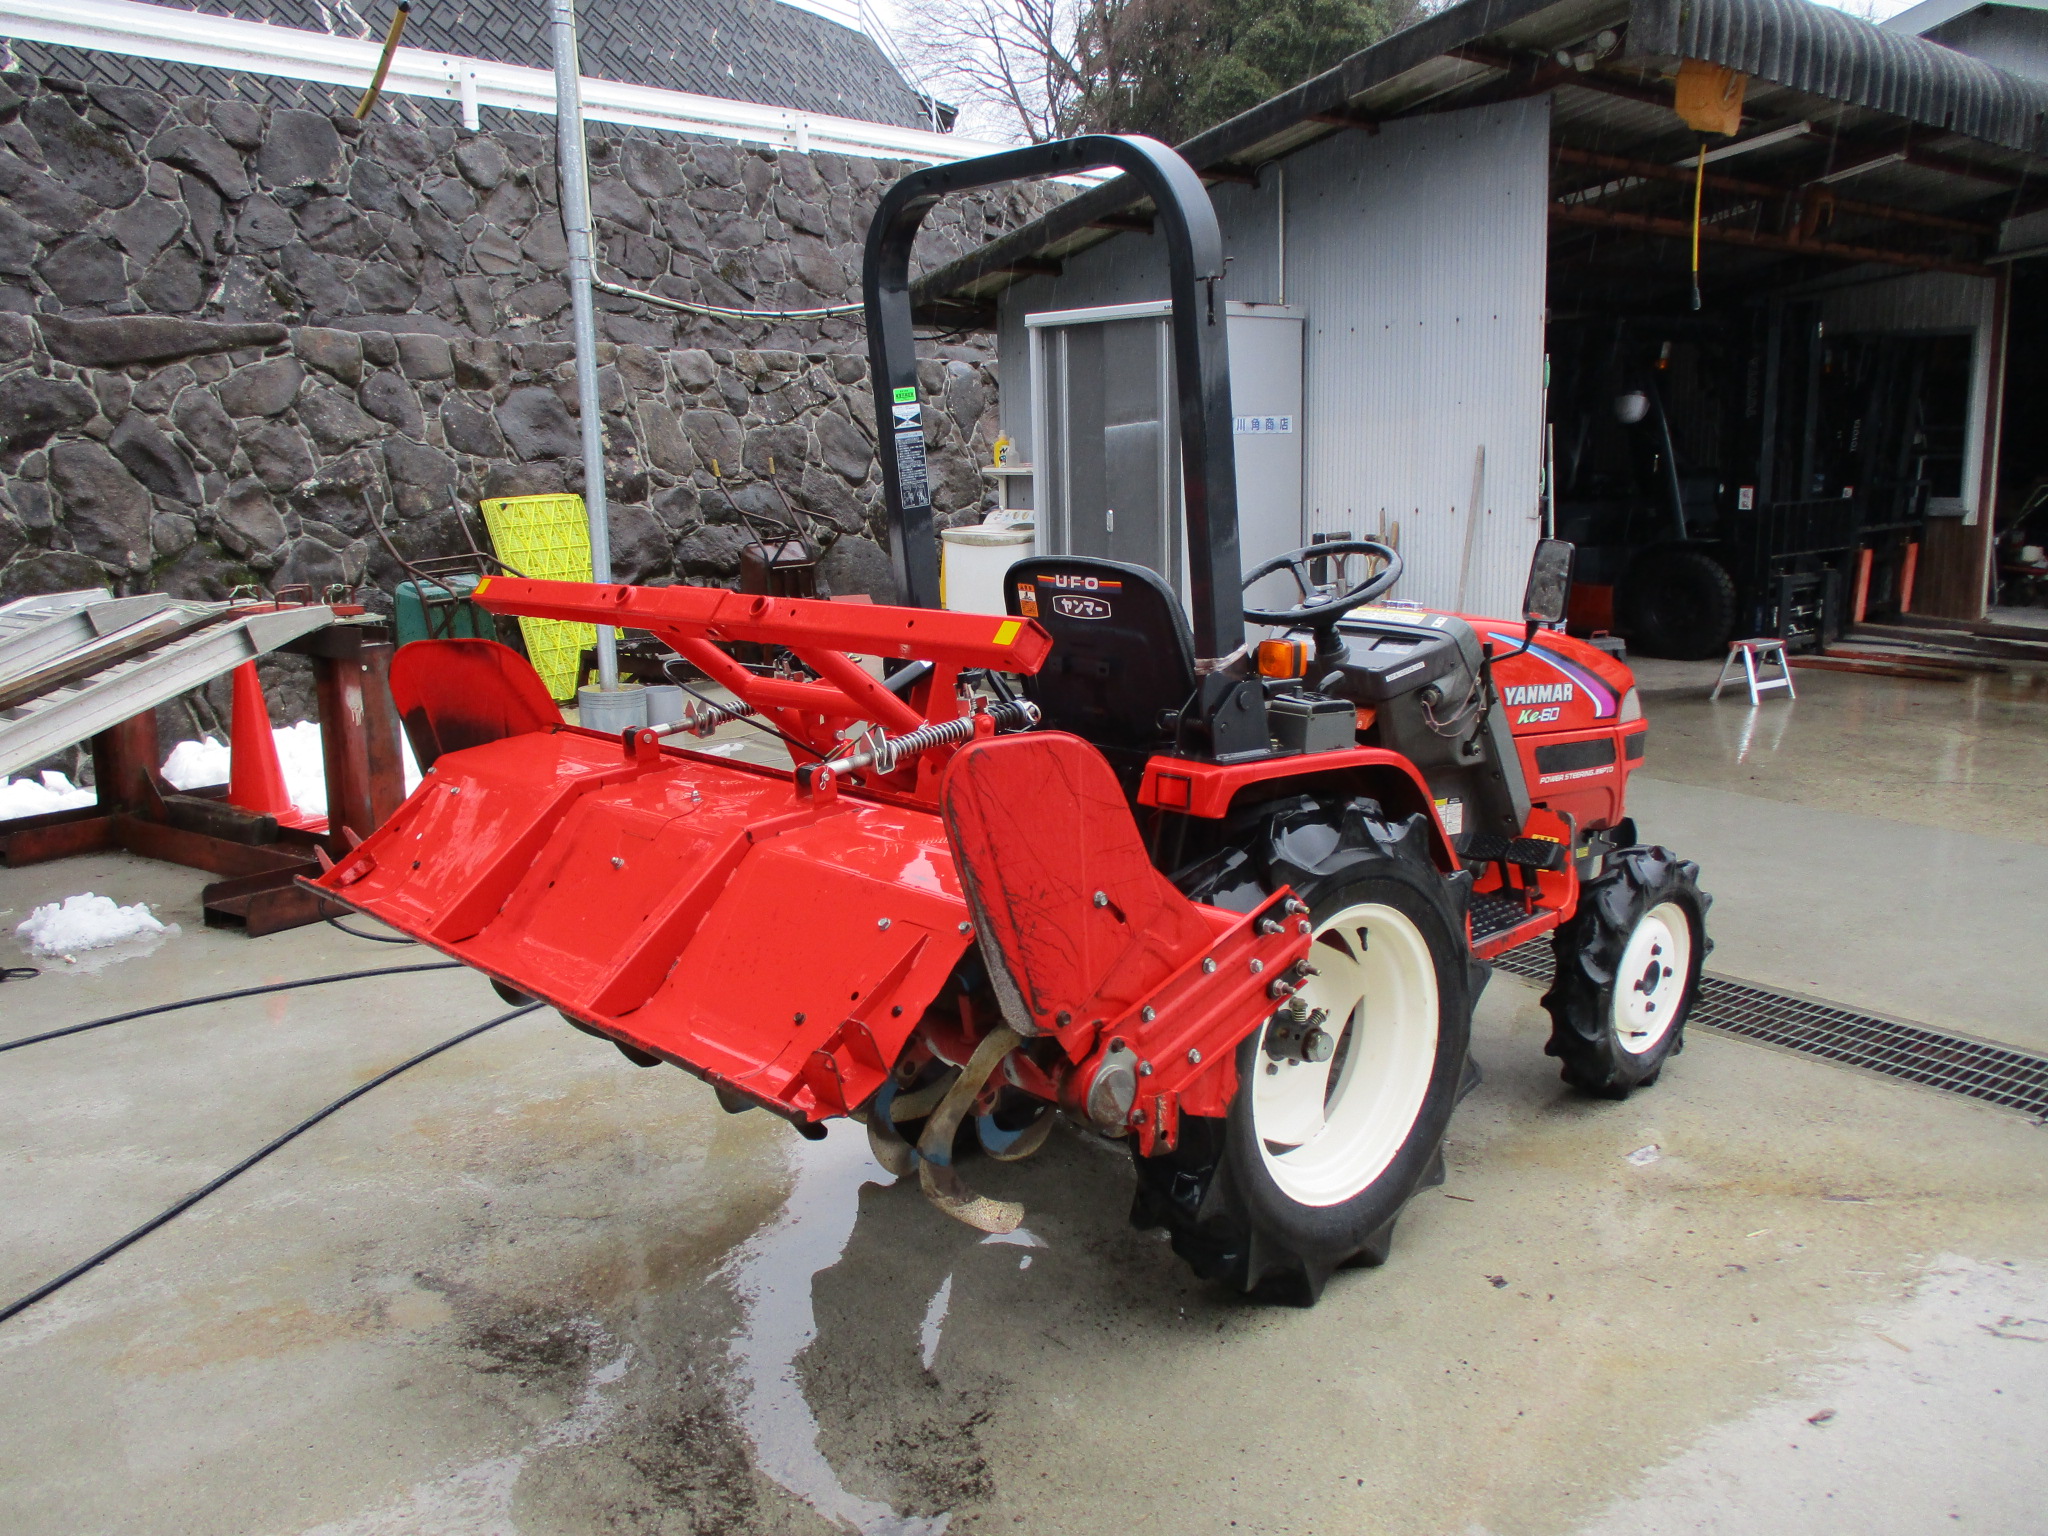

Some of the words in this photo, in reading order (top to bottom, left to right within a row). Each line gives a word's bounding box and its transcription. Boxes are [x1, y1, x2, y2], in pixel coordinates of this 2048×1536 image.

[1236, 417, 1289, 432] 川角商店
[1848, 418, 1862, 454] TOYOTA
[1055, 574, 1099, 590] UFO
[1061, 598, 1103, 616] ヤンマー
[1503, 683, 1574, 706] YANMAR
[1517, 706, 1560, 725] Ke-60
[1539, 774, 1564, 785] POWER
